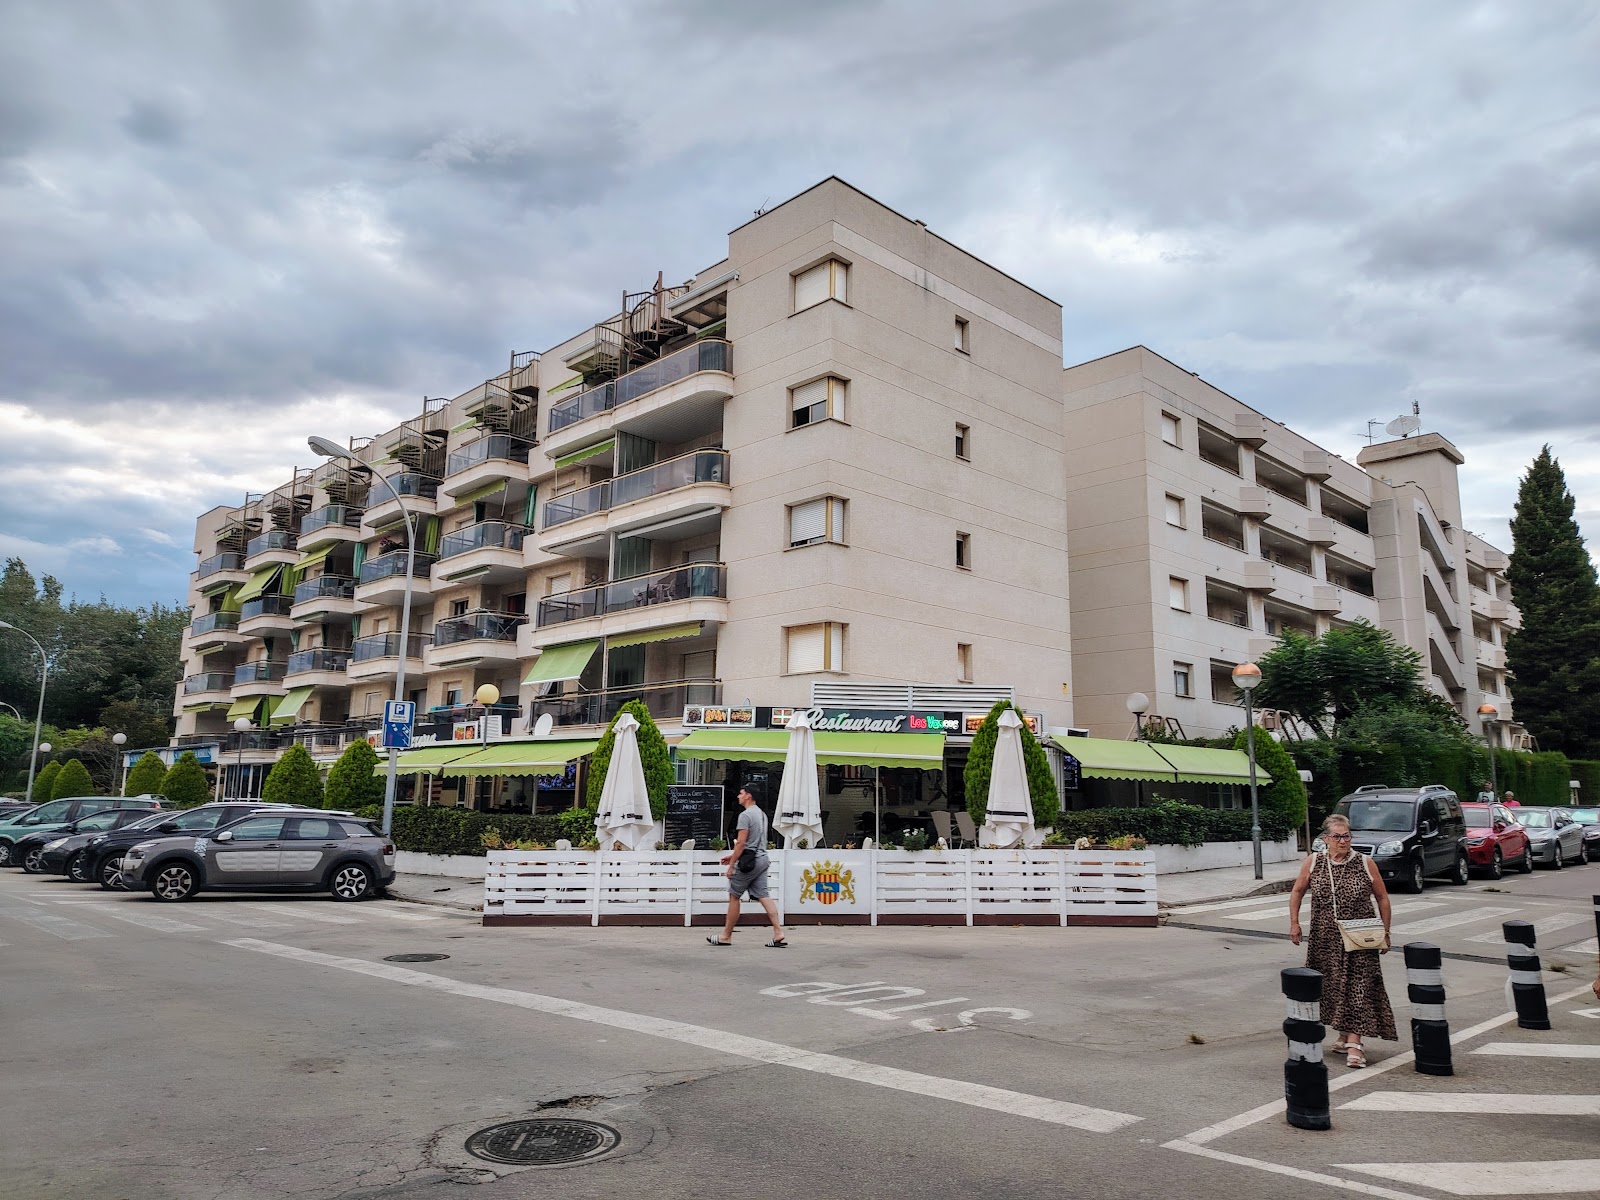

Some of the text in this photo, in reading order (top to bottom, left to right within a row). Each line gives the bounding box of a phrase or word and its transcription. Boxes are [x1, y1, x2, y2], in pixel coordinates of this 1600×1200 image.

[396, 705, 403, 713] P
[806, 707, 906, 732] Restaurant
[910, 715, 926, 728] Los
[759, 981, 1033, 1032] STOP
